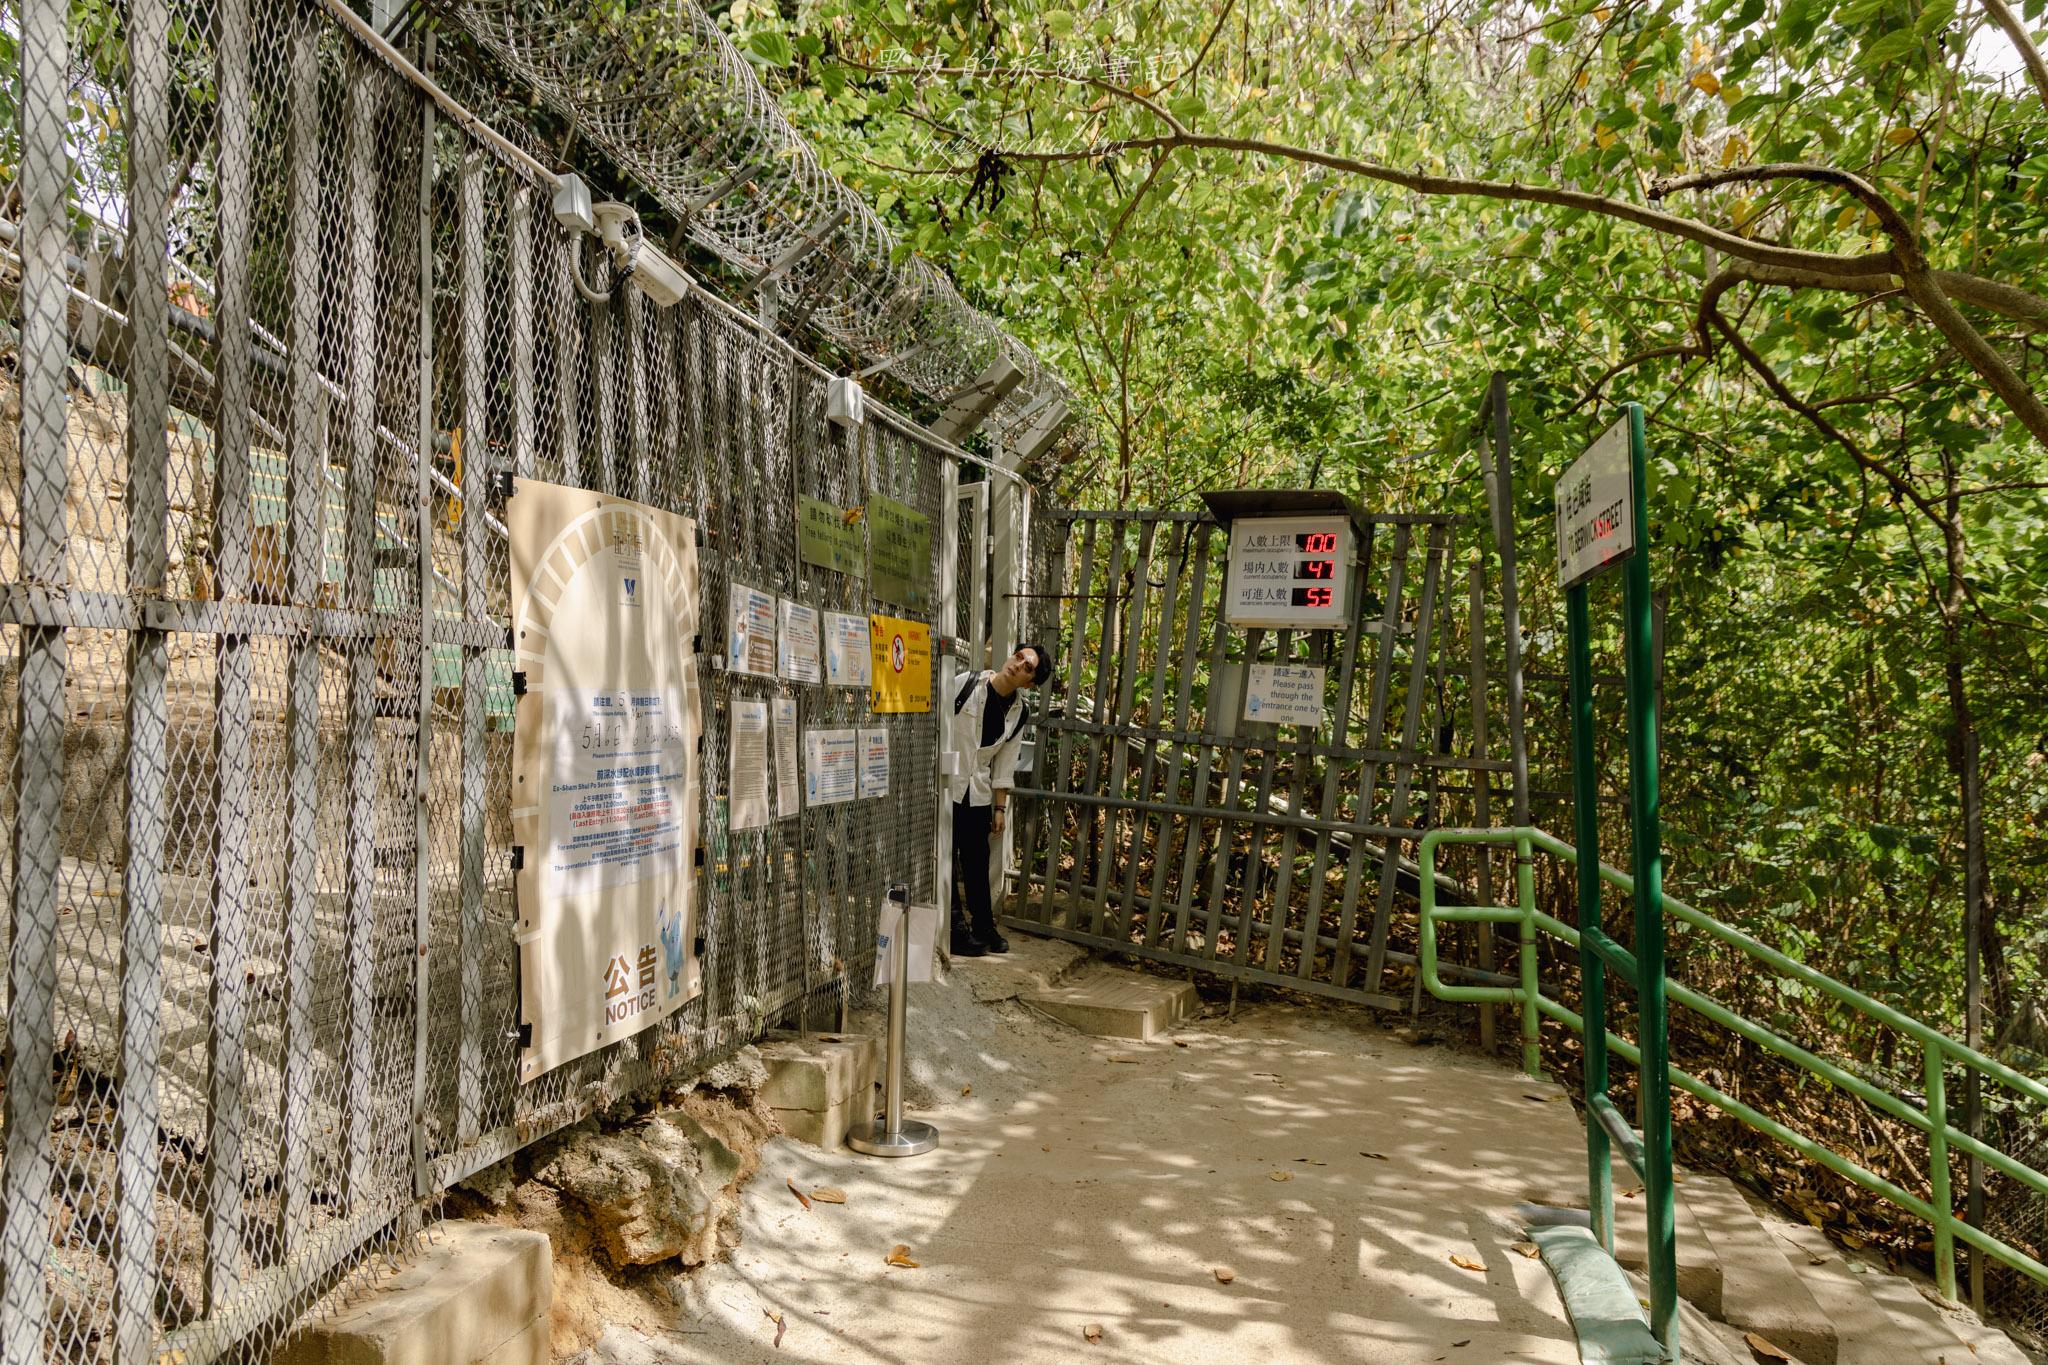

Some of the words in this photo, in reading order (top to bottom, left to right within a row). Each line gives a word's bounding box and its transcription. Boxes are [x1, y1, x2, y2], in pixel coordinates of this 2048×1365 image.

[1599, 498, 1623, 537] STREET
[1246, 535, 1291, 547] 人數上限
[1306, 533, 1337, 552] 100
[1243, 561, 1289, 573] 場內人數
[1308, 560, 1335, 578] 47
[1242, 588, 1287, 600] 可進人數
[1307, 587, 1332, 607] 53
[1273, 668, 1315, 679] 請逐一進入
[1273, 680, 1295, 688] Please
[1297, 682, 1314, 690] pass
[1271, 691, 1298, 701] through
[1301, 692, 1313, 701] the
[1261, 702, 1292, 710] entrance
[1310, 704, 1320, 715] by
[598, 780, 615, 788] Service
[574, 803, 595, 811] 9:00am
[573, 819, 589, 828] (Last
[603, 944, 657, 1000] 公告
[605, 988, 656, 1026] NOTICE
